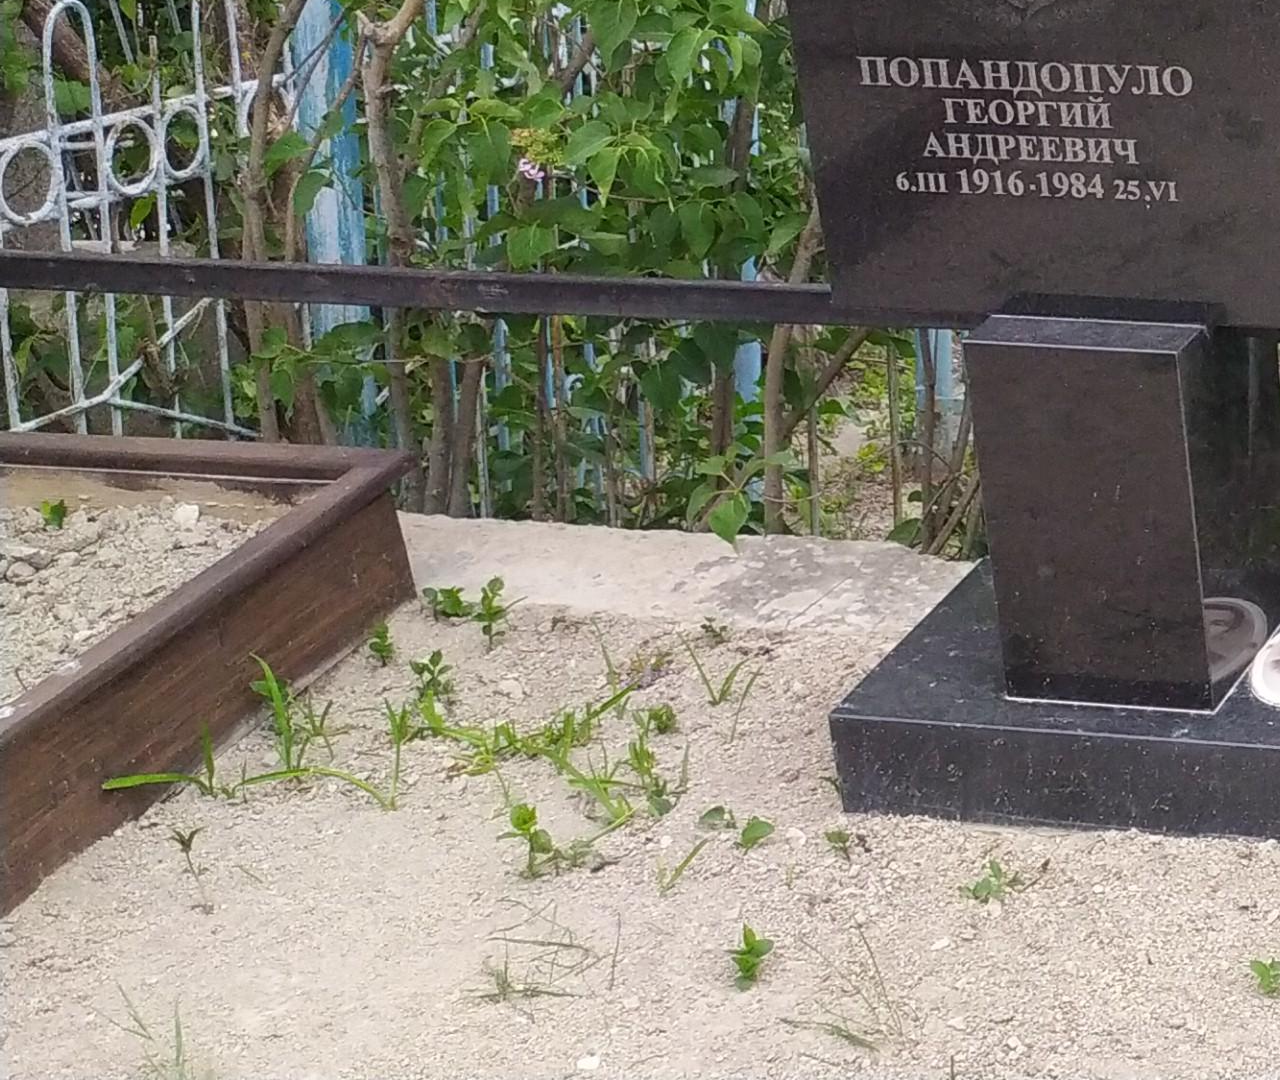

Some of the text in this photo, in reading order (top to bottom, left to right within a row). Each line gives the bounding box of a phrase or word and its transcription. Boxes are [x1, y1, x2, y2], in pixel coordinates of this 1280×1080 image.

[856, 56, 1193, 98] ПОПАНДОПУЛО
[942, 97, 1113, 129] ГЕОРГИЙ
[922, 131, 1140, 165] АНДРЕЕВИЧ
[957, 169, 1104, 199] 1916-1984
